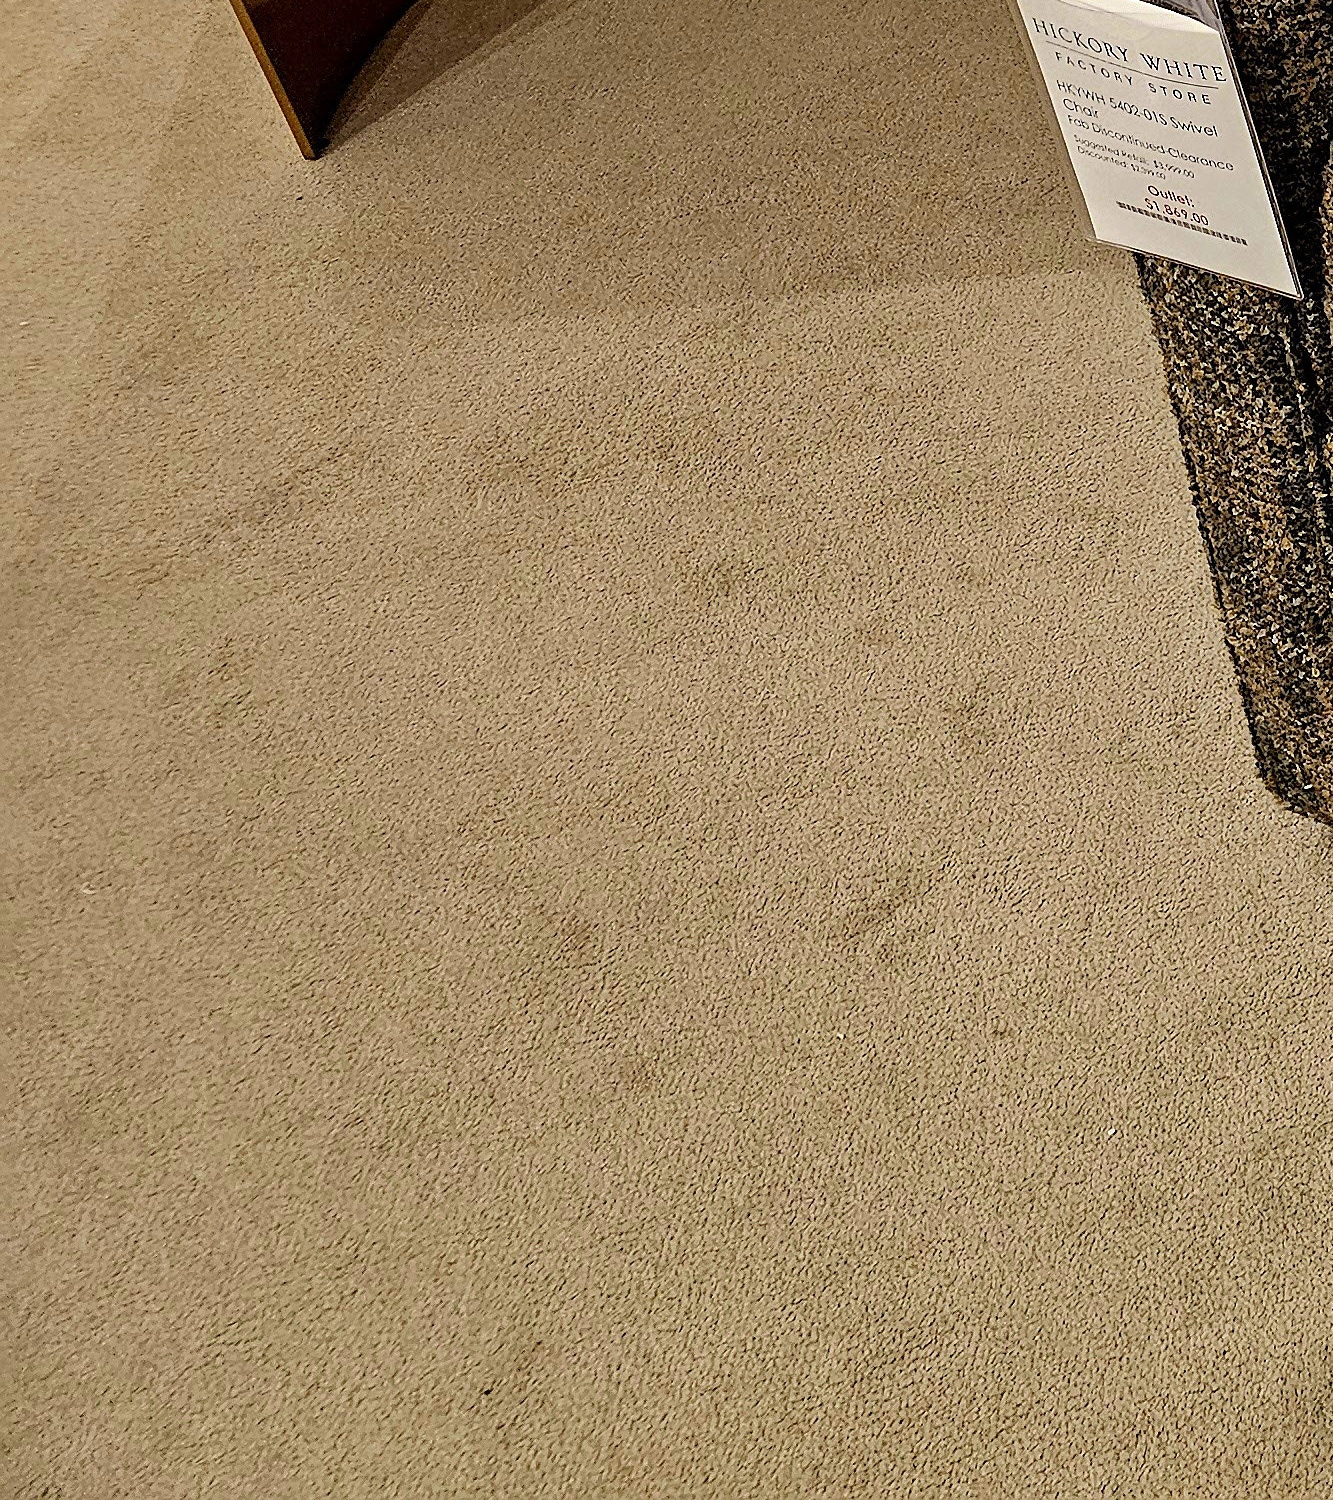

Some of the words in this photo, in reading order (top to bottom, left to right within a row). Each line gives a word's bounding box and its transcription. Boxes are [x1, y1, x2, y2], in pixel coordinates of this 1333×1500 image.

[1032, 17, 1129, 62] HICKORY
[1139, 53, 1227, 82] WHITE
[1055, 52, 1133, 86] FACTORY
[1148, 82, 1212, 105] STORE
[1056, 79, 1106, 105] HKYWH
[1170, 116, 1219, 137] Swivel
[1063, 98, 1099, 119] Chair
[1067, 114, 1090, 130] Fab
[1147, 185, 1195, 208] Outlet:
